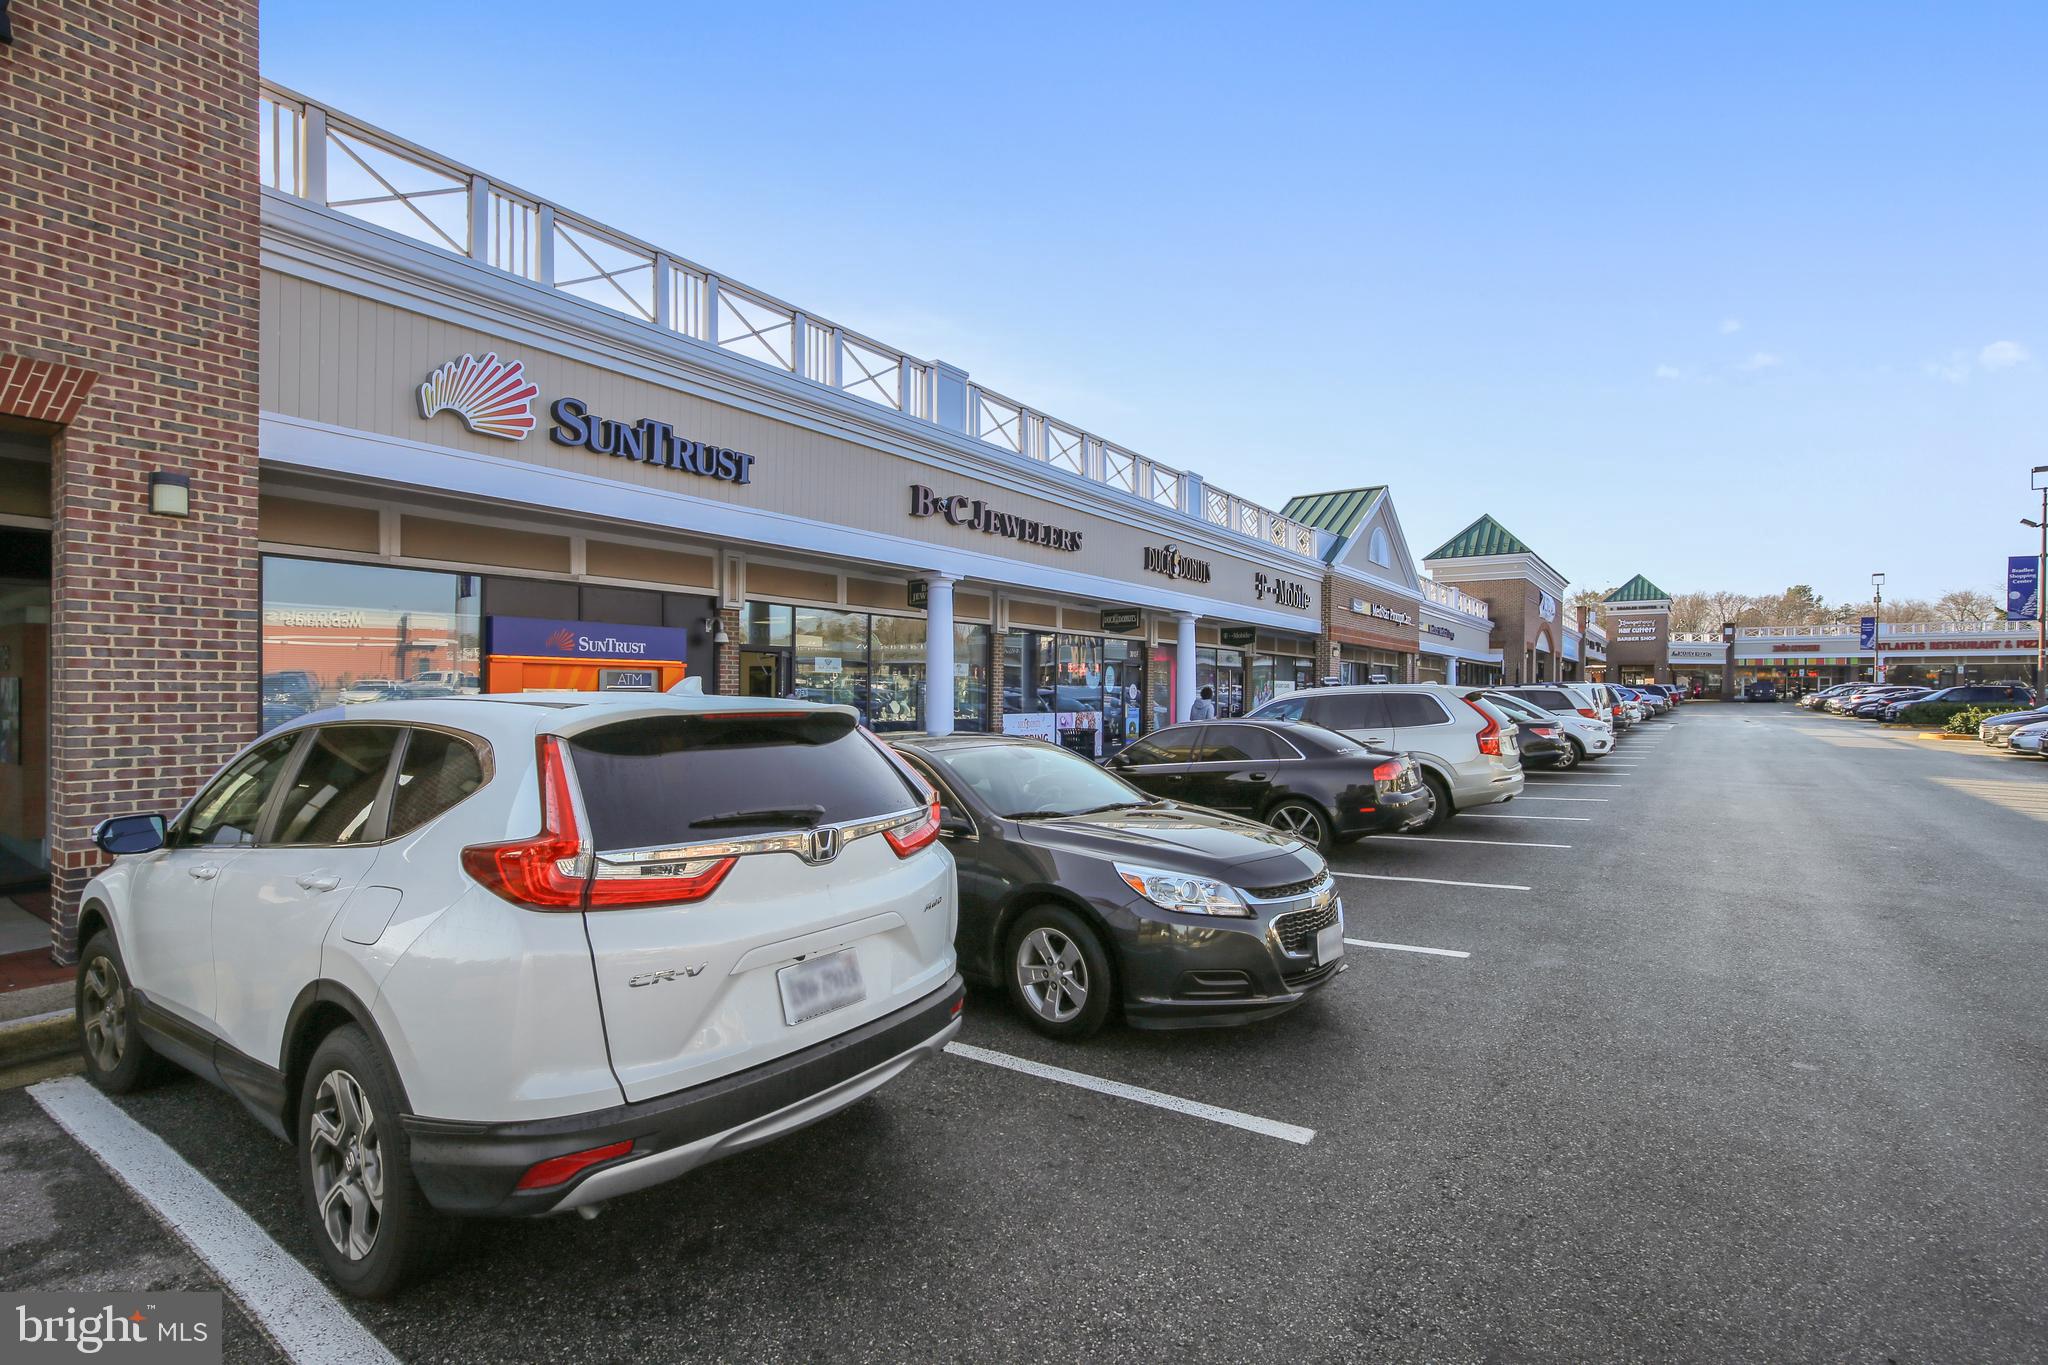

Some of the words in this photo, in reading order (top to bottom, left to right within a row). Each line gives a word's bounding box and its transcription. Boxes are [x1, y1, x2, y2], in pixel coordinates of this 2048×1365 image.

[550, 397, 755, 484] SUNTRUST
[968, 500, 1083, 551] JEWELERS
[1144, 546, 1175, 576] DUCK
[578, 636, 647, 654] SUNTRUST
[1930, 641, 2001, 650] RESTAURANT
[2004, 640, 2013, 649] &
[617, 673, 643, 685] ATM
[629, 961, 708, 988] CR-V
